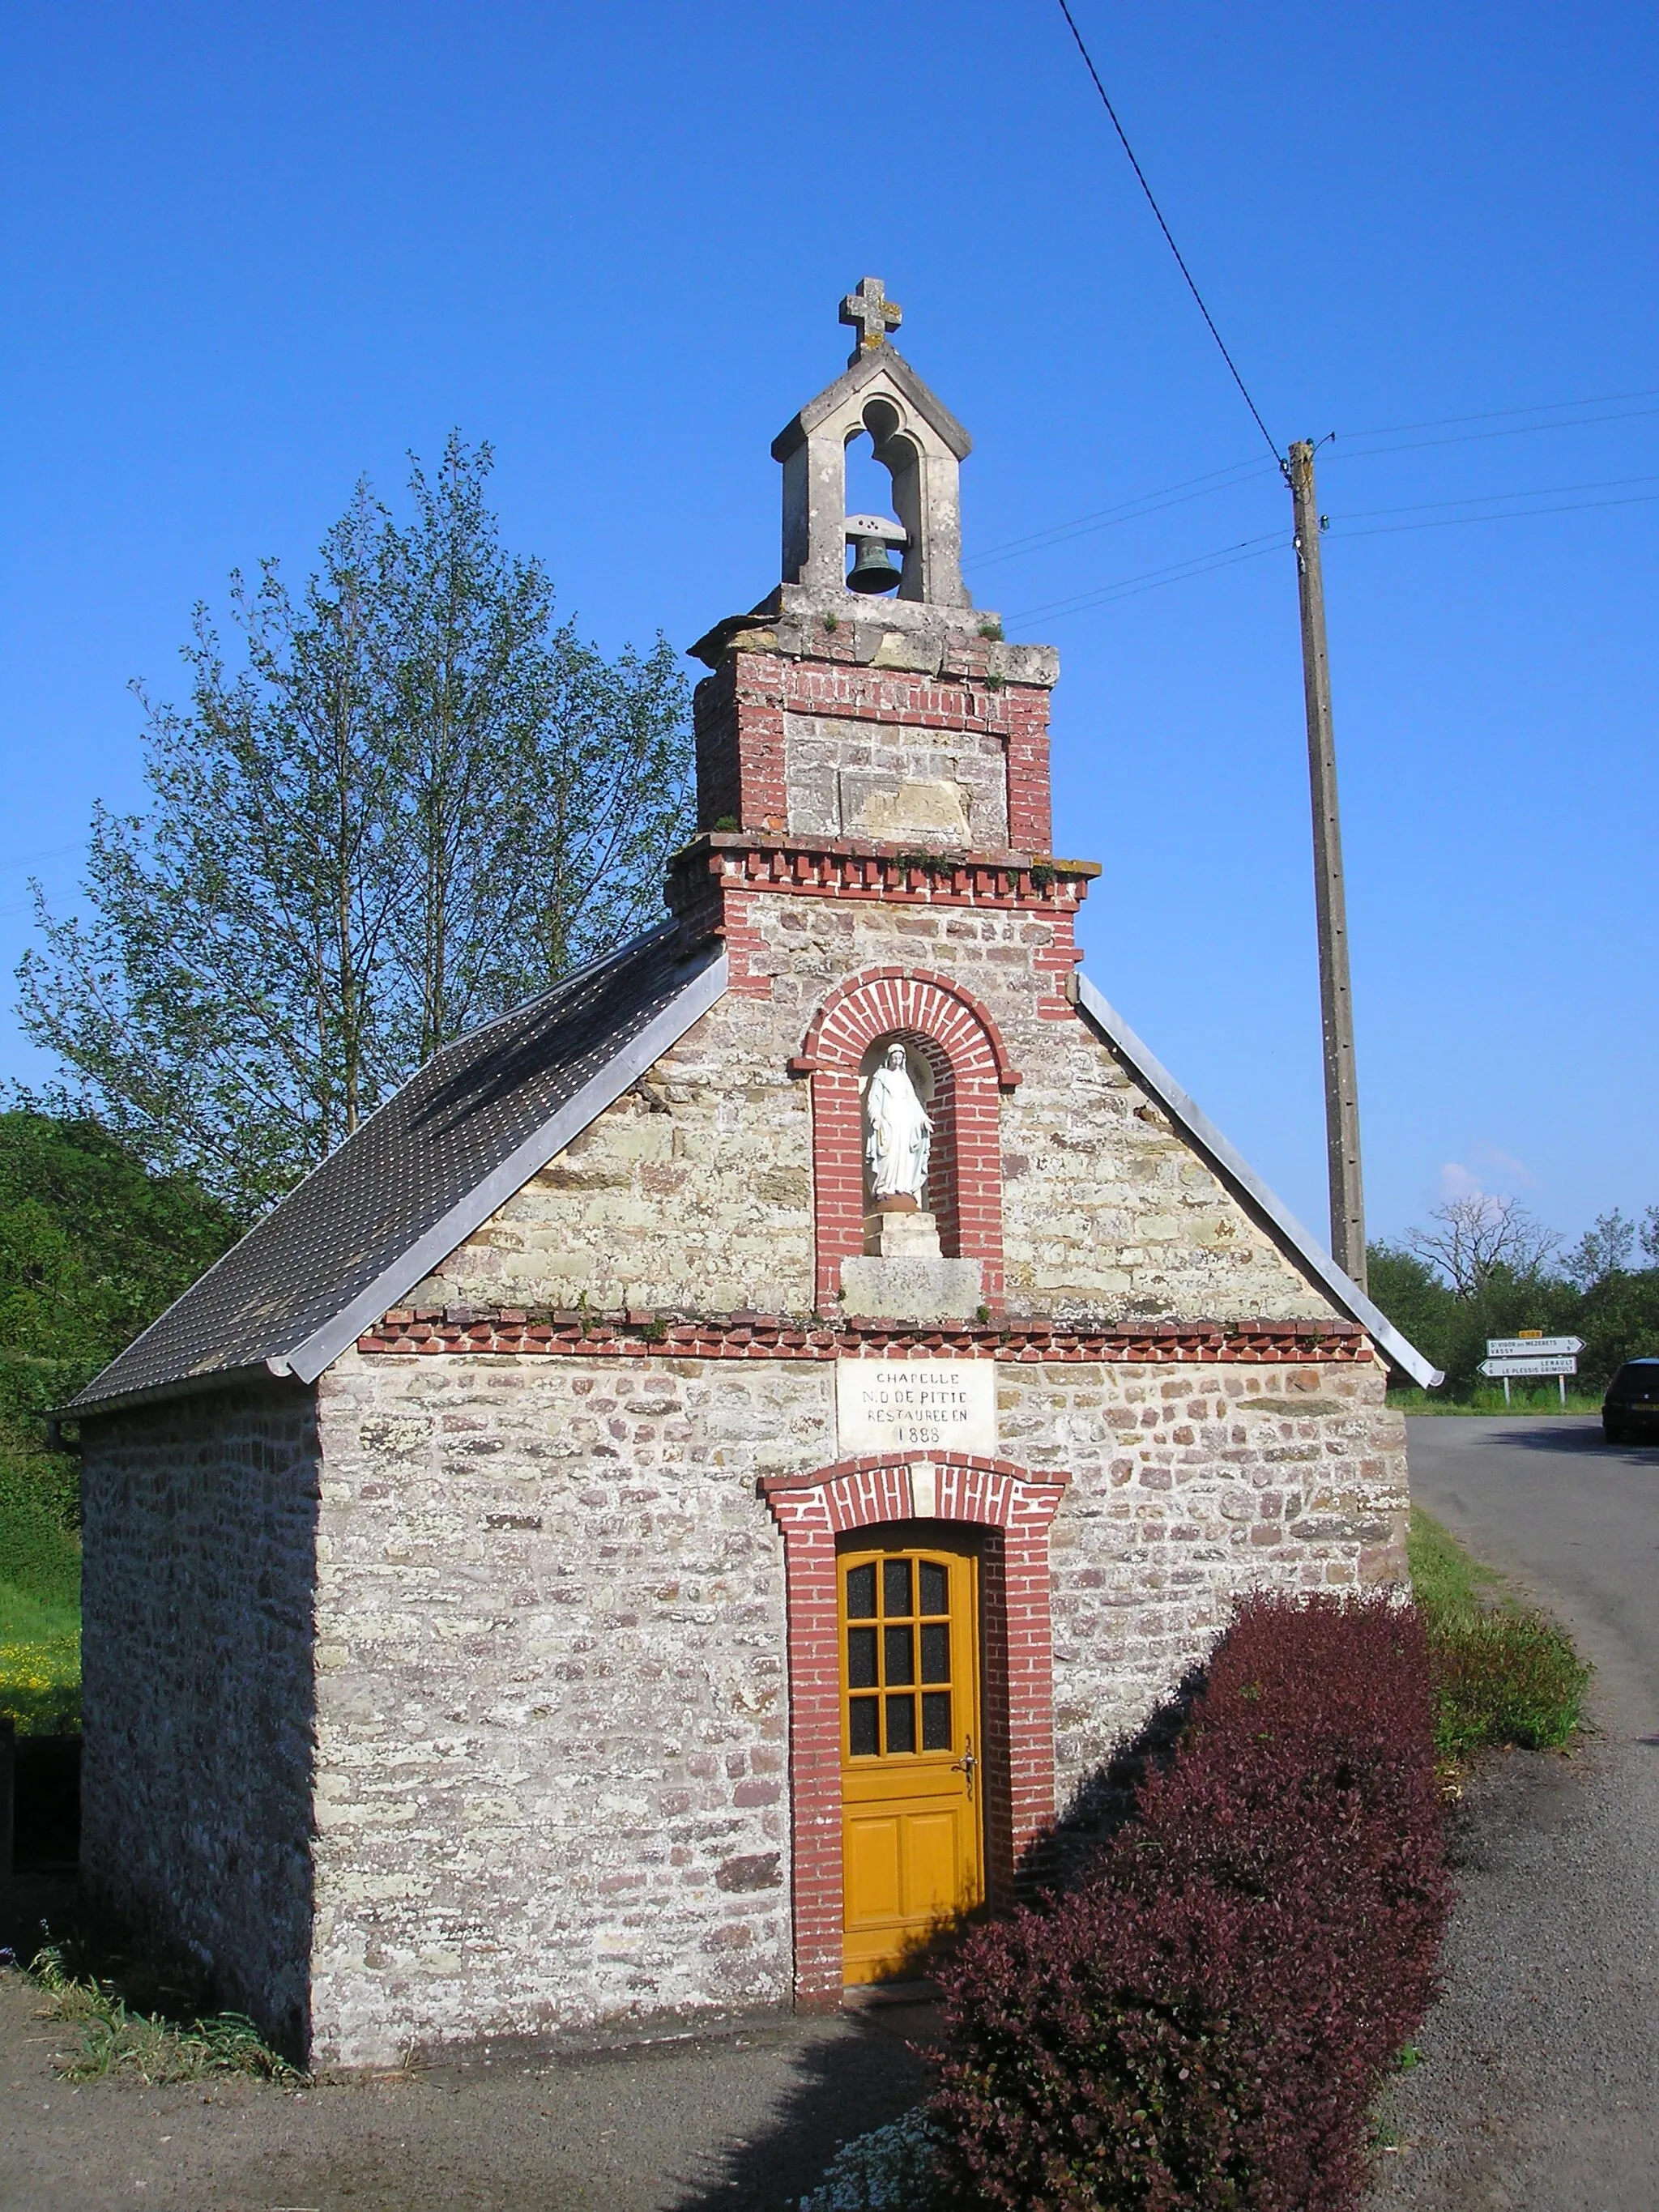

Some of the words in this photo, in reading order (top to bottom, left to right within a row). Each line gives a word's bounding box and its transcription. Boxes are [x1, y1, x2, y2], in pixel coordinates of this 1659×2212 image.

[876, 1373, 959, 1384] CHAPELLE
[895, 1390, 914, 1403] DE
[868, 1409, 948, 1422] RESTAUREE
[953, 1409, 967, 1421] EN
[899, 1427, 940, 1443] 1888
